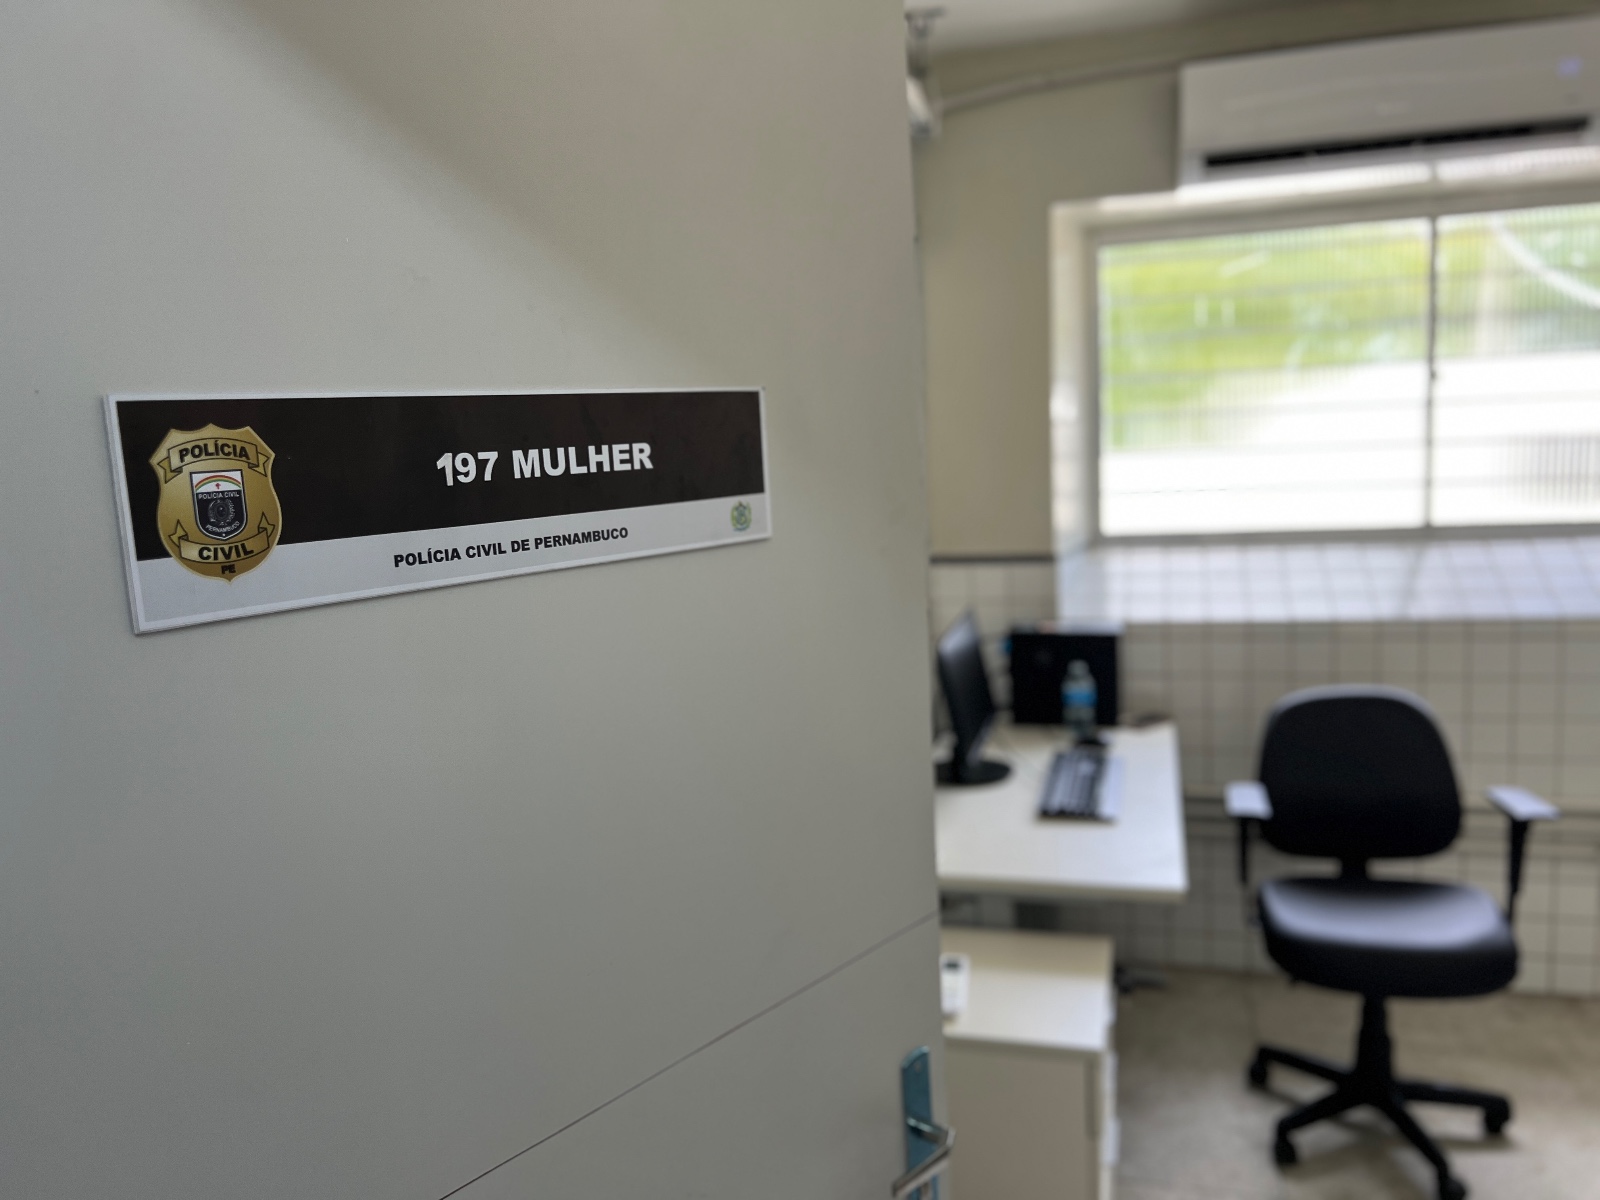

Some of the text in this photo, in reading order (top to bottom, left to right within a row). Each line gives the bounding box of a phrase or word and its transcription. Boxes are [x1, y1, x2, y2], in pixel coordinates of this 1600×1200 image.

[179, 440, 250, 463] POLÍCIA
[436, 442, 654, 486] 197 MULHER
[198, 543, 254, 561] CIVIL
[394, 527, 629, 567] POLÍCIA CIVIL DE PERNAMBUCO
[221, 564, 236, 574] PE
